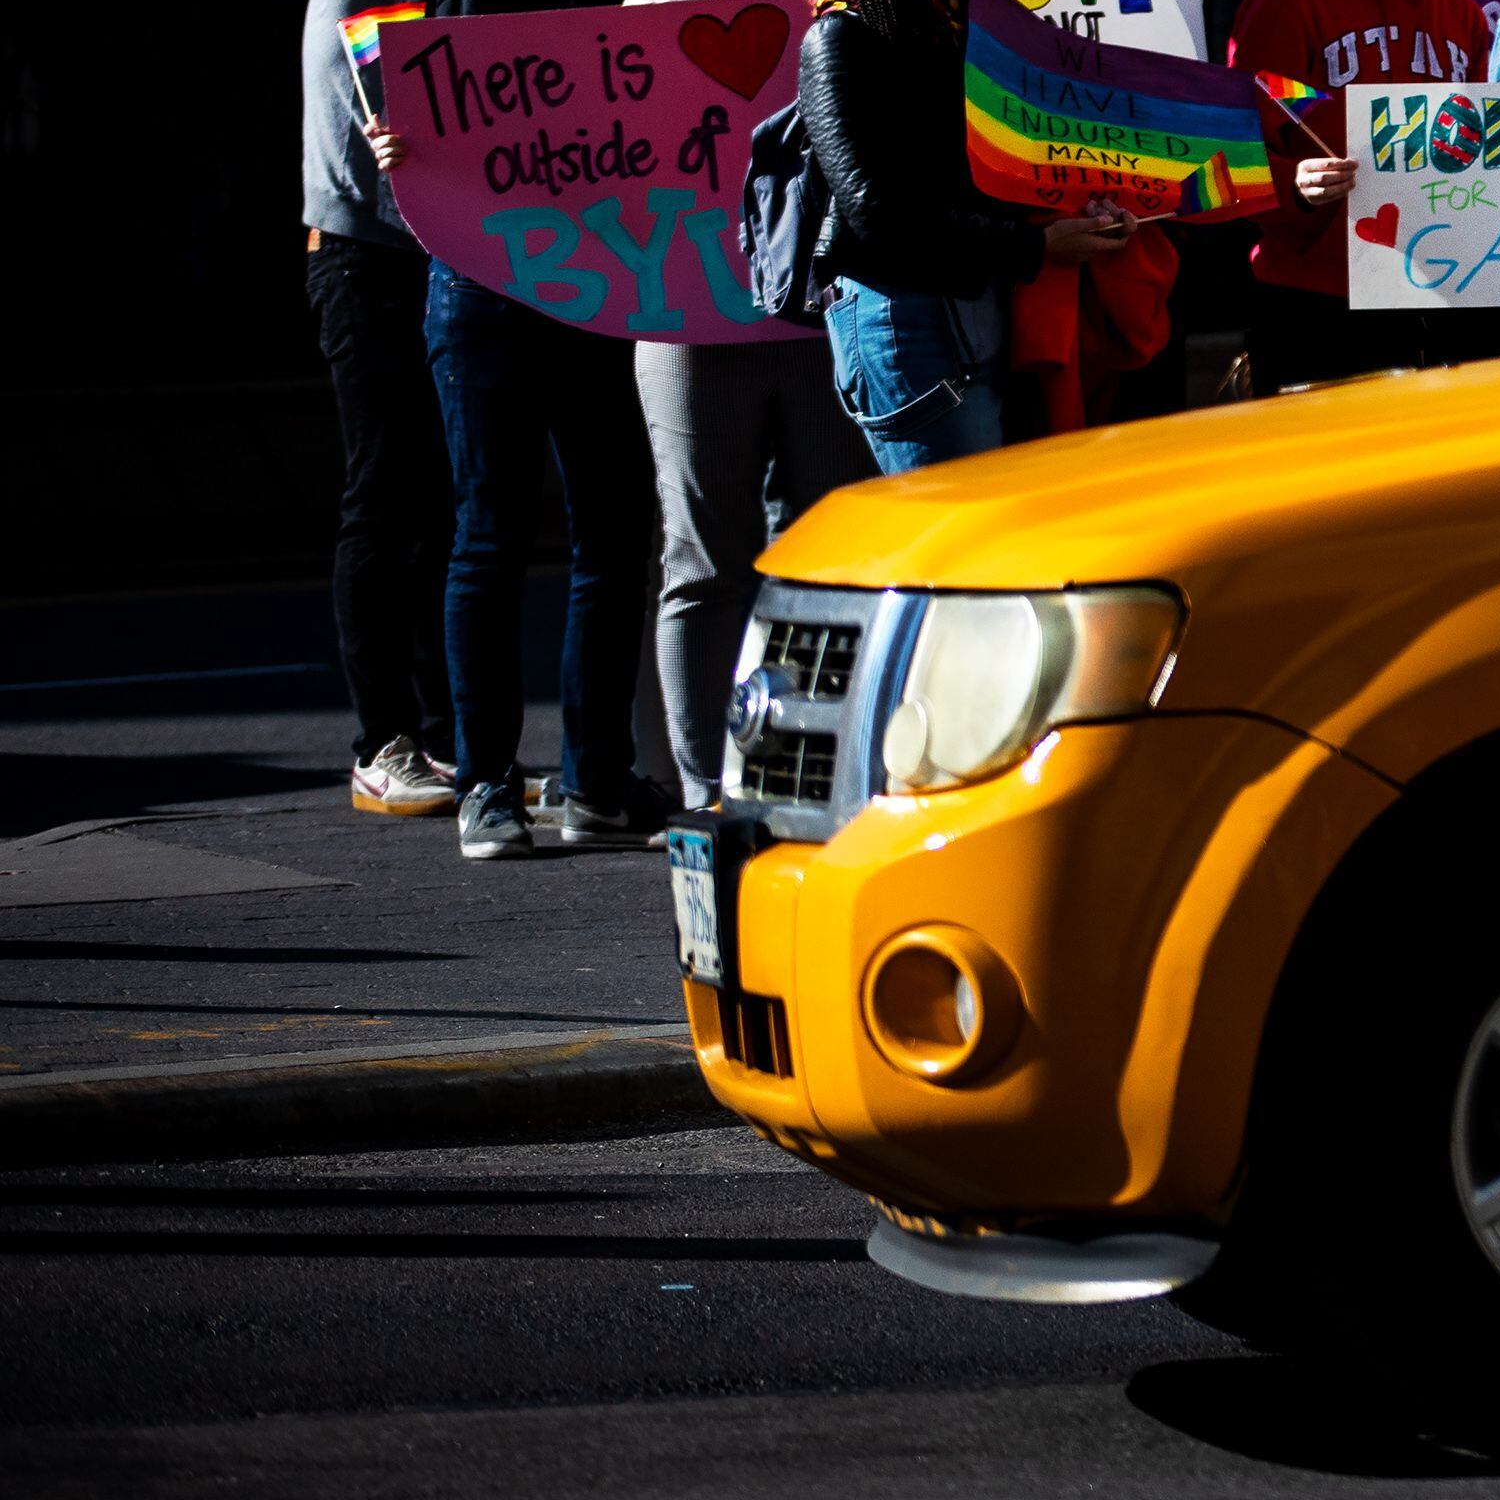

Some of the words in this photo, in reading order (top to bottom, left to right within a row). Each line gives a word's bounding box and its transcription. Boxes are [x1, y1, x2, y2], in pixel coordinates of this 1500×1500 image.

[402, 35, 575, 136] There
[597, 35, 654, 101] is
[484, 120, 659, 196] outside
[678, 104, 729, 192] of
[1003, 95, 1190, 157] ENDURED
[1030, 164, 1168, 193] THINGS
[1048, 144, 1140, 170] MANY
[1421, 179, 1499, 215] FOR
